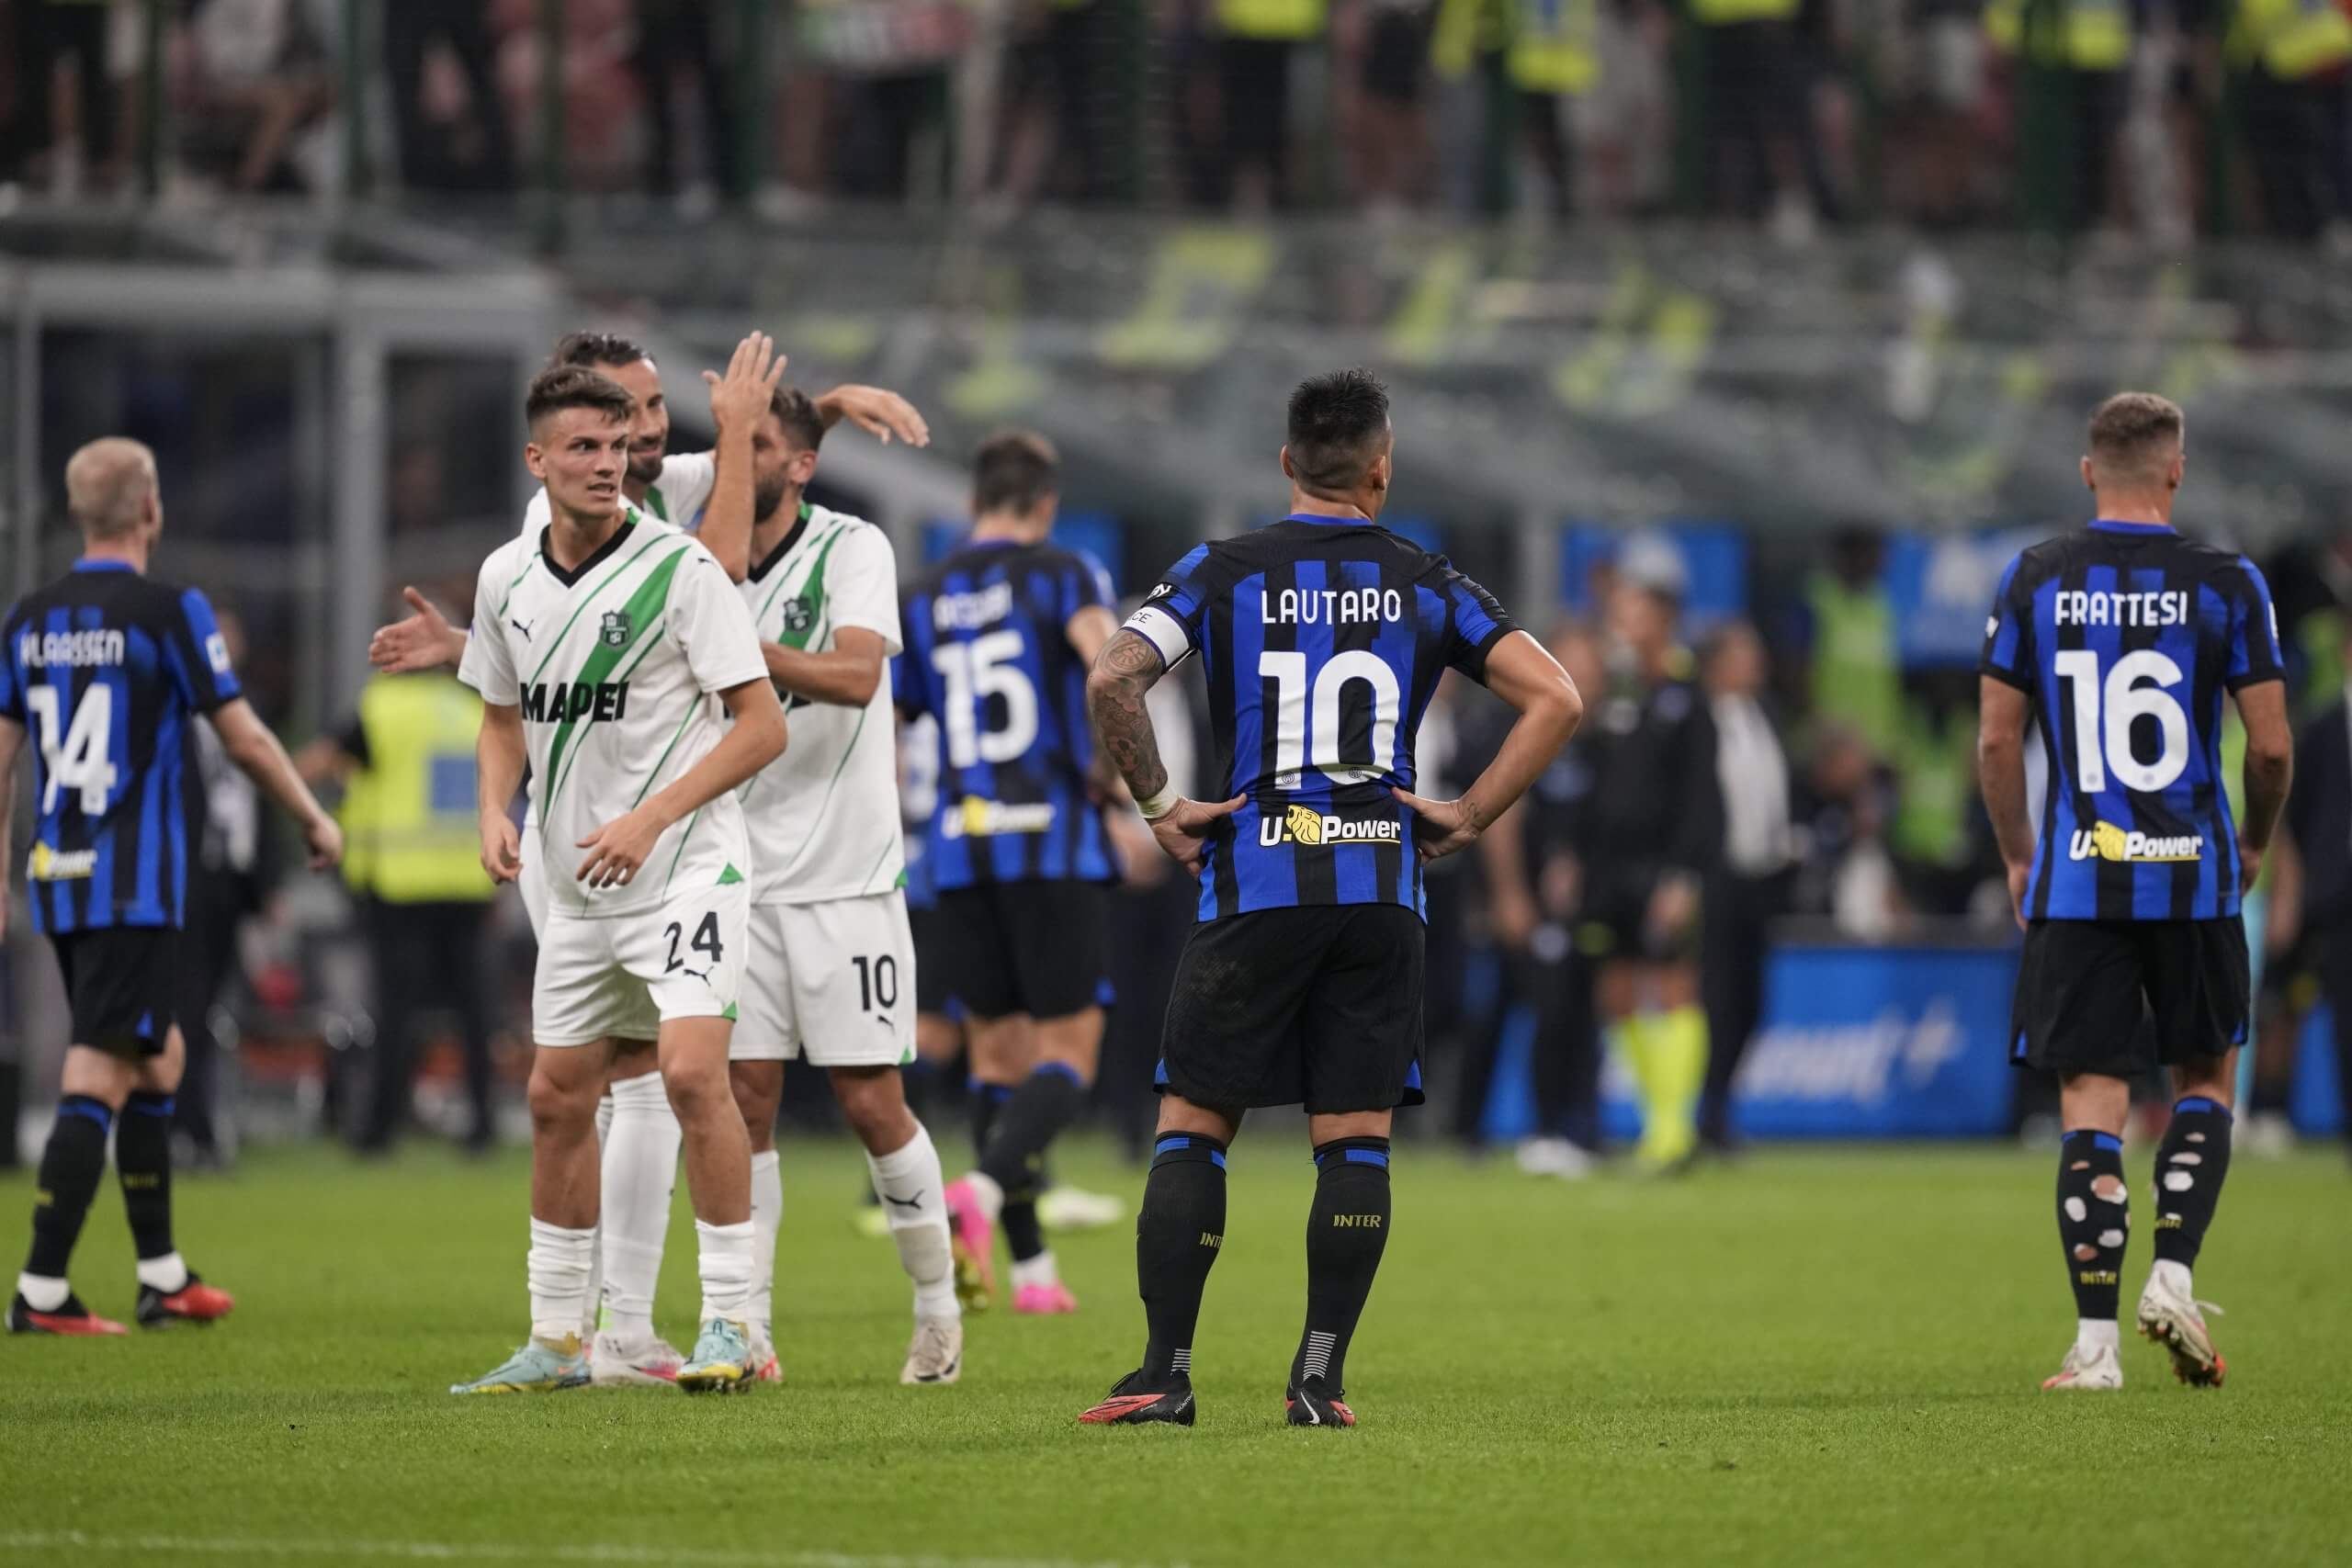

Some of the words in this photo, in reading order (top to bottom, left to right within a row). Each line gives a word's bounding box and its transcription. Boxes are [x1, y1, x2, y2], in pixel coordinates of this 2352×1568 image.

[1261, 588, 1401, 626] LAUTARO
[2054, 591, 2188, 626] FRATTESI
[520, 681, 629, 723] MAPEI
[932, 629, 1039, 770] 15
[1259, 649, 1401, 790] 10
[2054, 649, 2189, 793] 16
[27, 682, 118, 816] 14
[663, 911, 723, 974] 24
[852, 954, 898, 1011] 10
[1333, 1214, 1382, 1228] INTER
